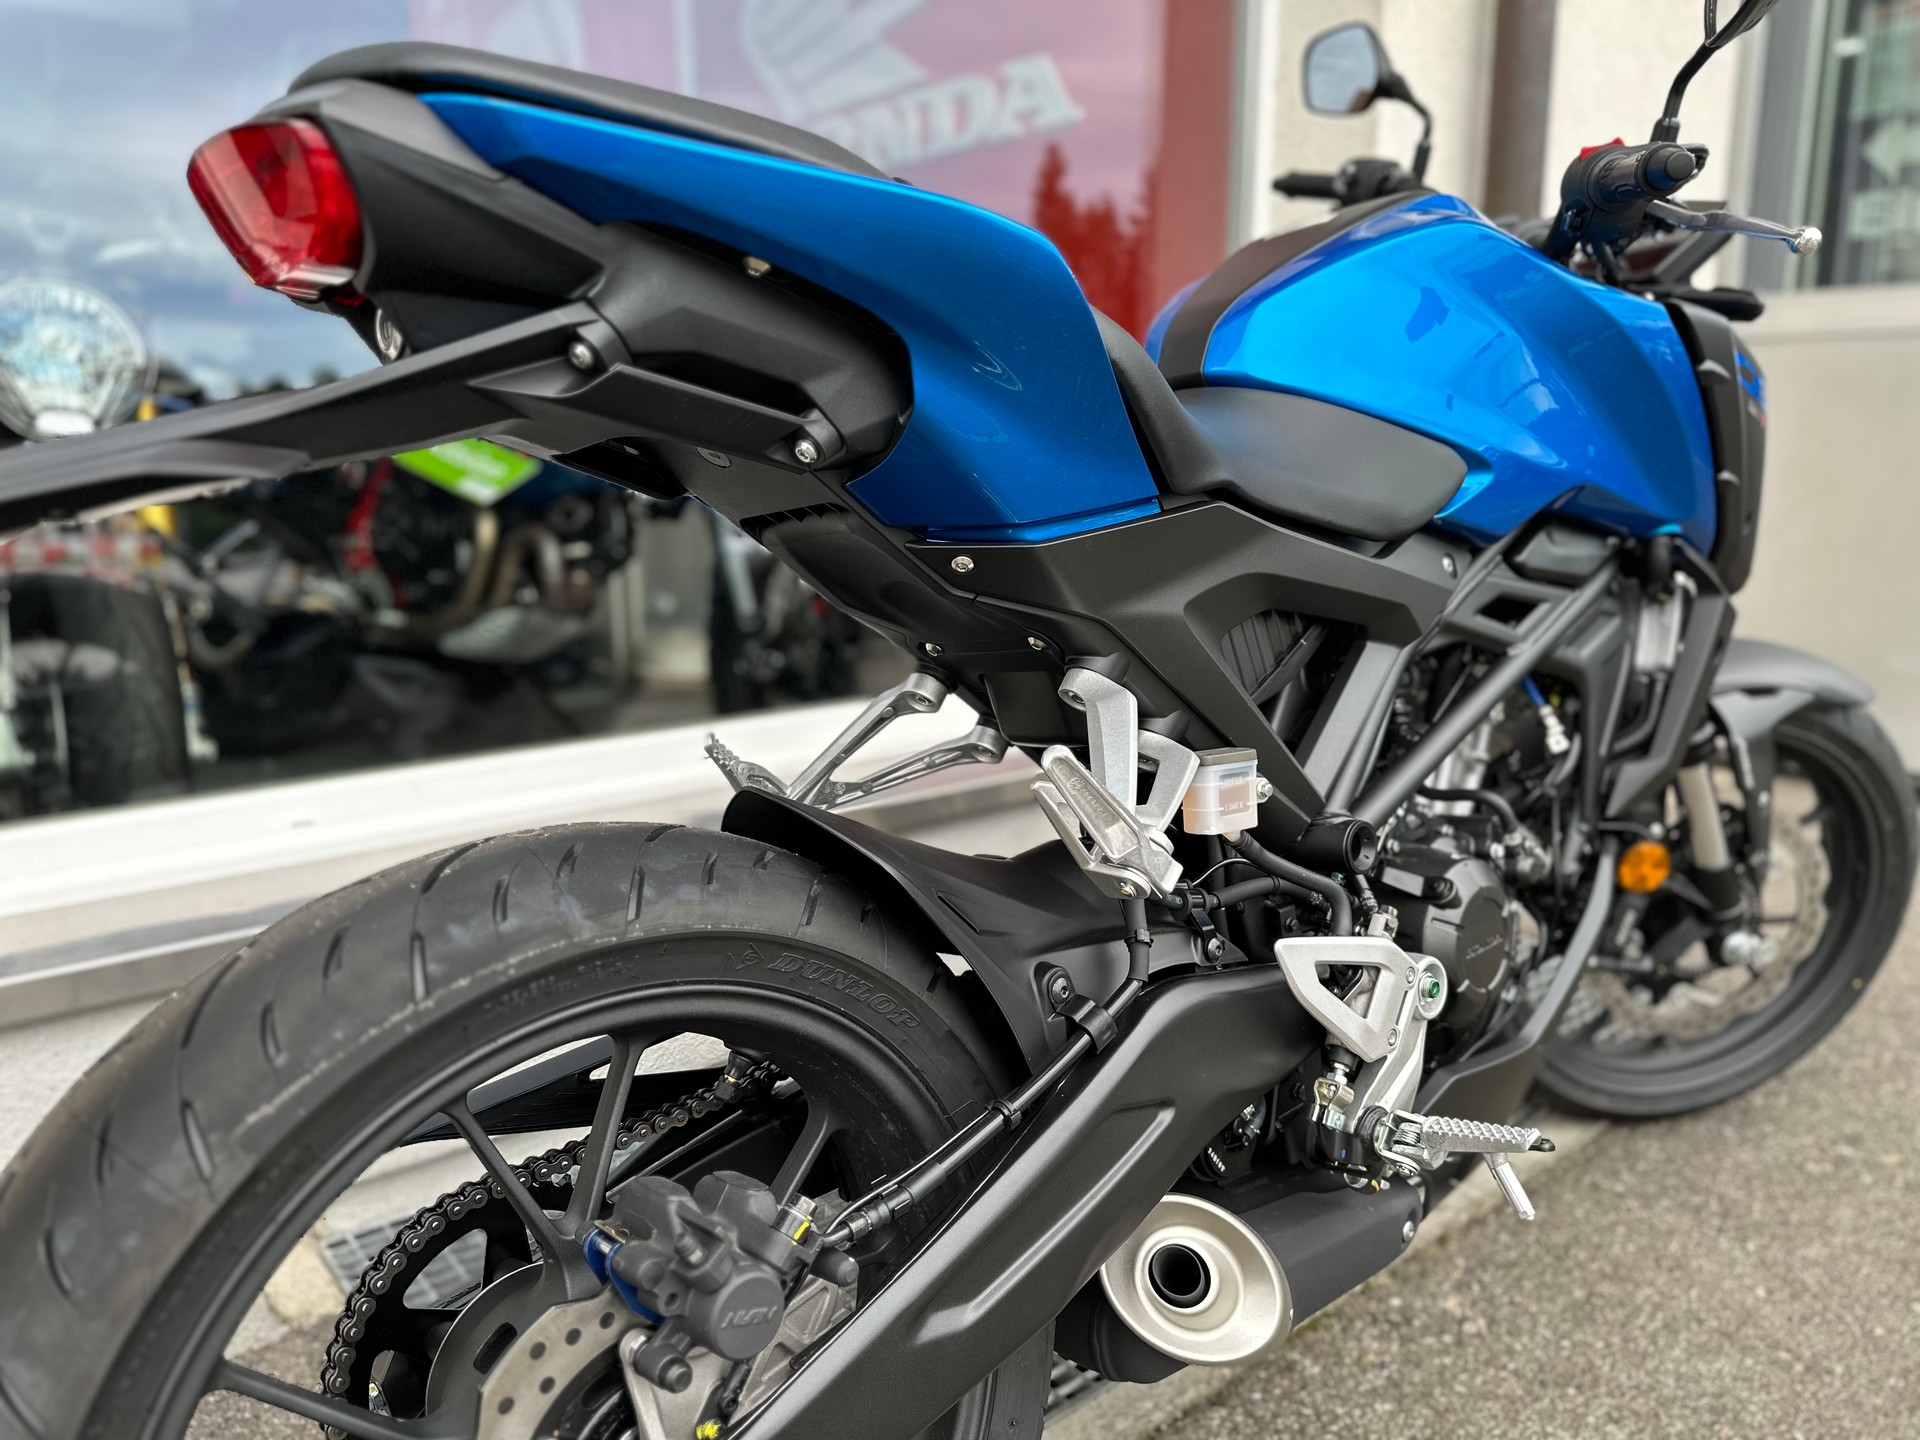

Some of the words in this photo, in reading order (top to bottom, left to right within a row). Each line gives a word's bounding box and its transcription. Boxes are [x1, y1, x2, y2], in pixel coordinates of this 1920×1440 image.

[812, 52, 1086, 169] NDA
[1225, 801, 1244, 812] LOWER
[768, 953, 921, 1028] DUNLOP
